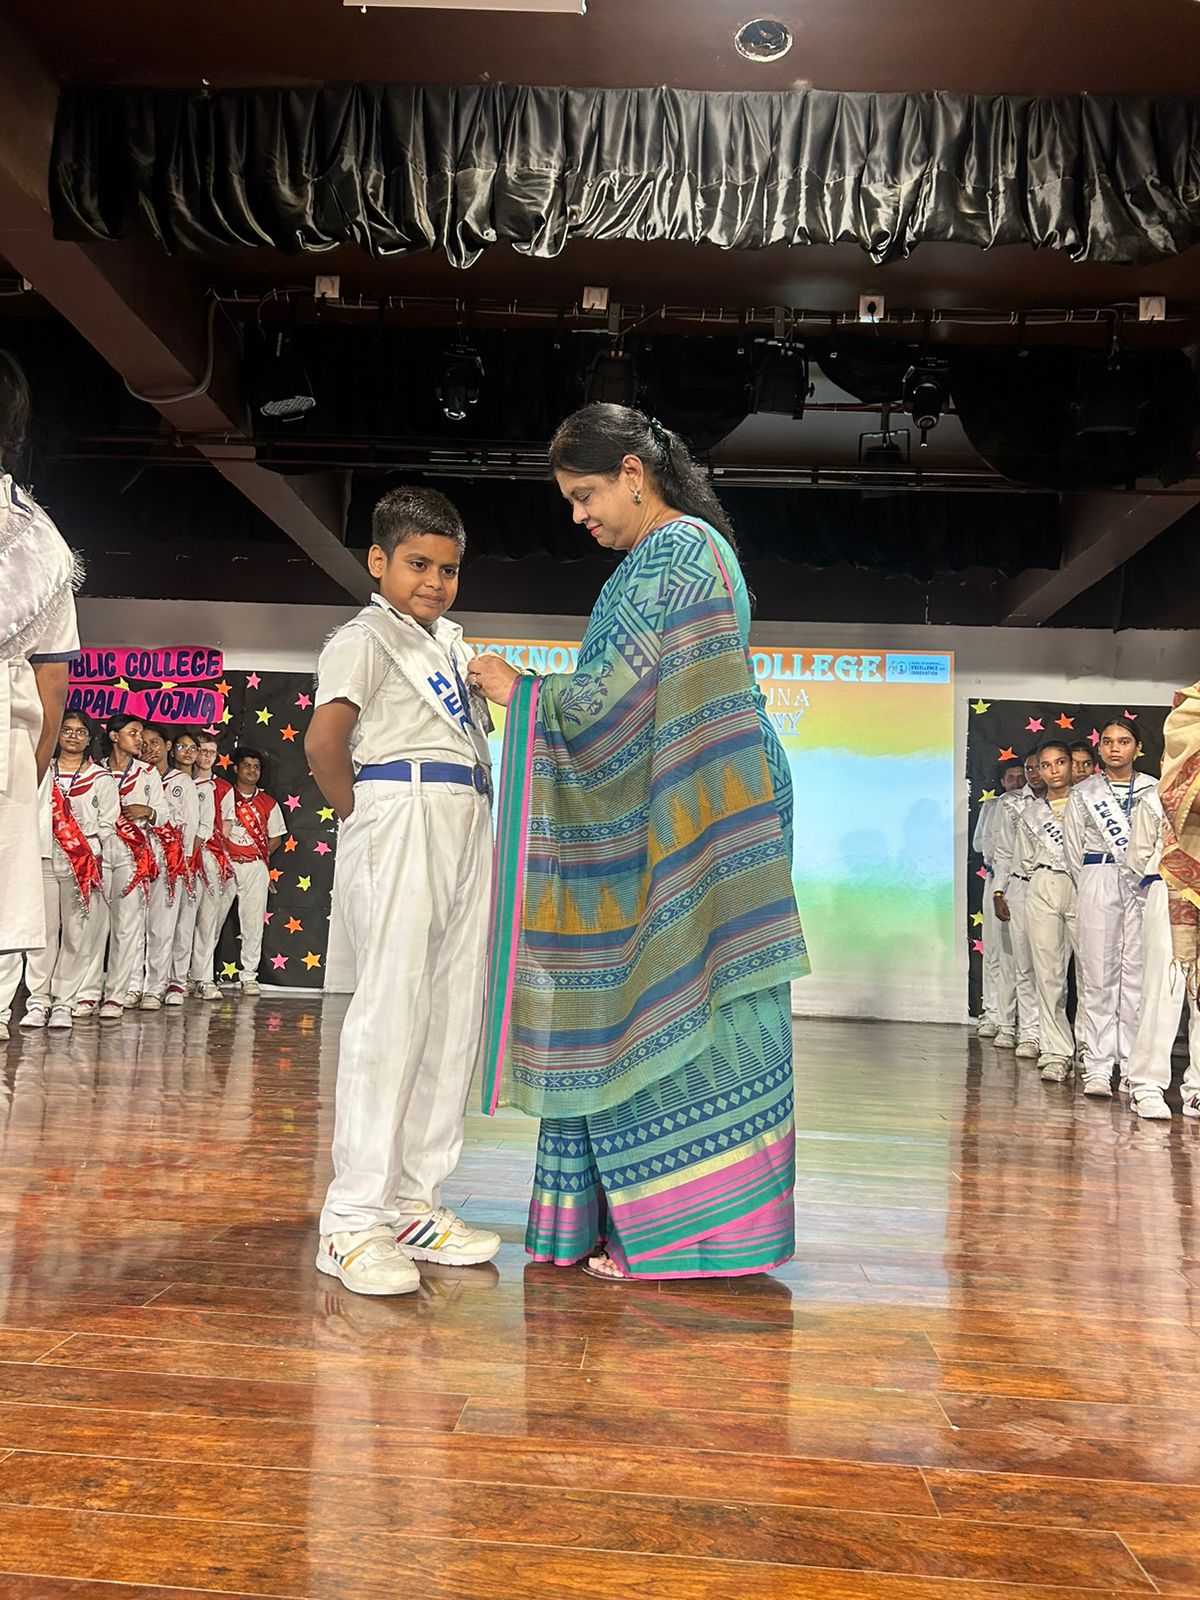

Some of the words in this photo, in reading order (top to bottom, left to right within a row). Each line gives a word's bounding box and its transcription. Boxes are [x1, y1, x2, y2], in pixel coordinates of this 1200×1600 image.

[125, 650, 220, 677] COLLEGE
[67, 688, 129, 718] APALI
[145, 690, 216, 724] YOJNA
